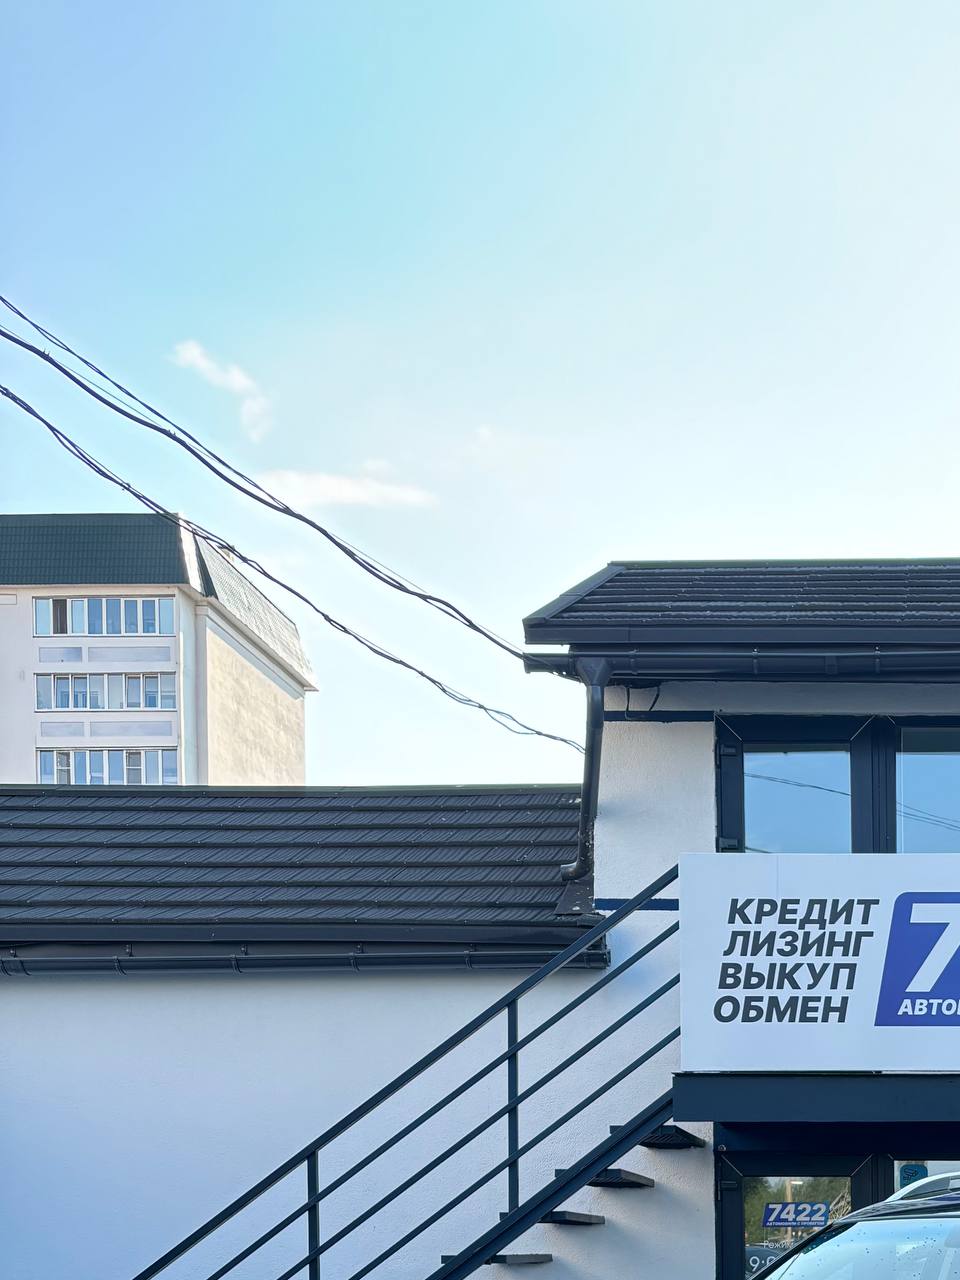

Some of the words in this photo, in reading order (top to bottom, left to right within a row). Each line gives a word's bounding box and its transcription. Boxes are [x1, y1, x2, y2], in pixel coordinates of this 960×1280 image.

[727, 898, 880, 930] КРЕДИТ
[722, 930, 874, 957] ЛИЗИНГ
[718, 962, 857, 990] ВЫКУП
[713, 995, 849, 1023] ОБМЕН
[768, 1203, 826, 1221] 7422
